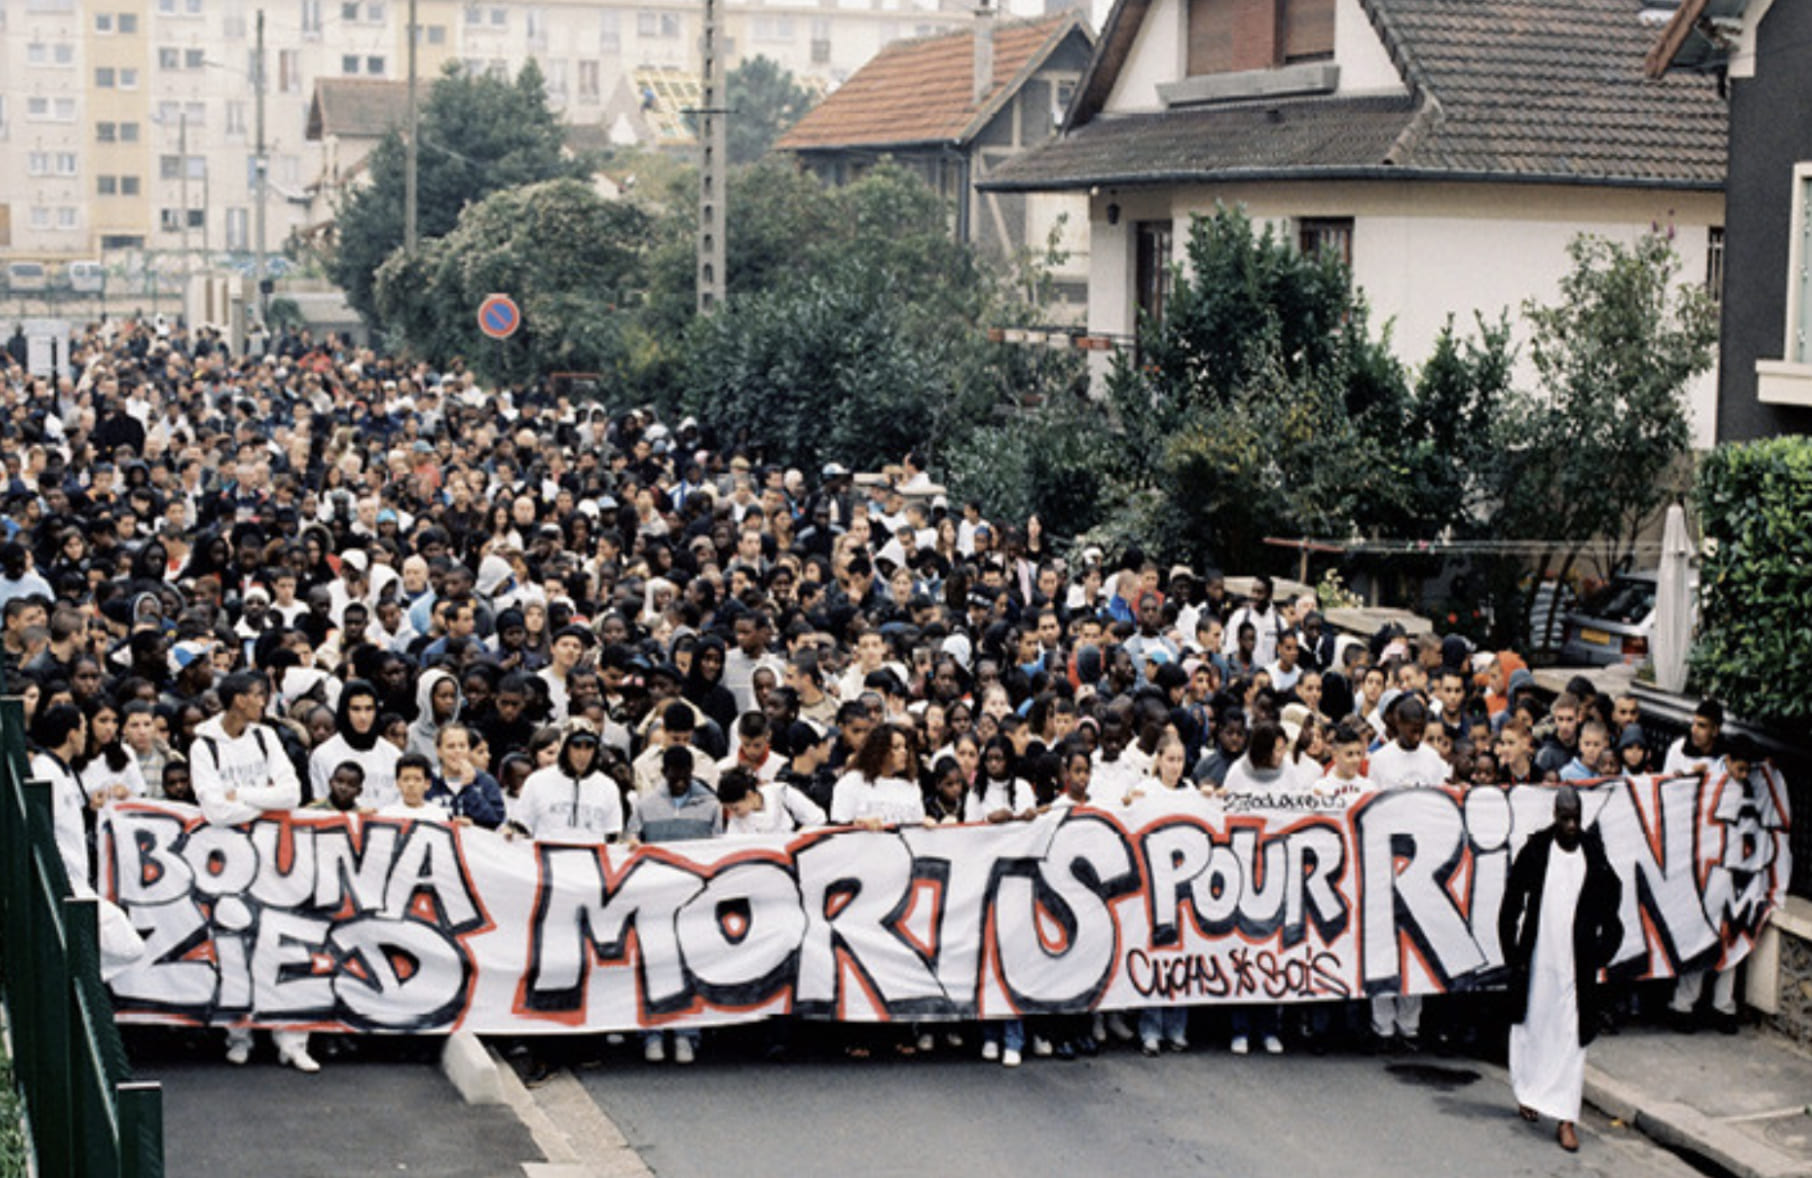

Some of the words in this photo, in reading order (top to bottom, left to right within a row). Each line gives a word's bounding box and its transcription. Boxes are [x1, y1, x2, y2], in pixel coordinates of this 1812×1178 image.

[105, 808, 487, 933] BOUNA
[521, 811, 1142, 1018] MORTS
[1140, 819, 1349, 949] POUR
[1355, 776, 1719, 988] RiN
